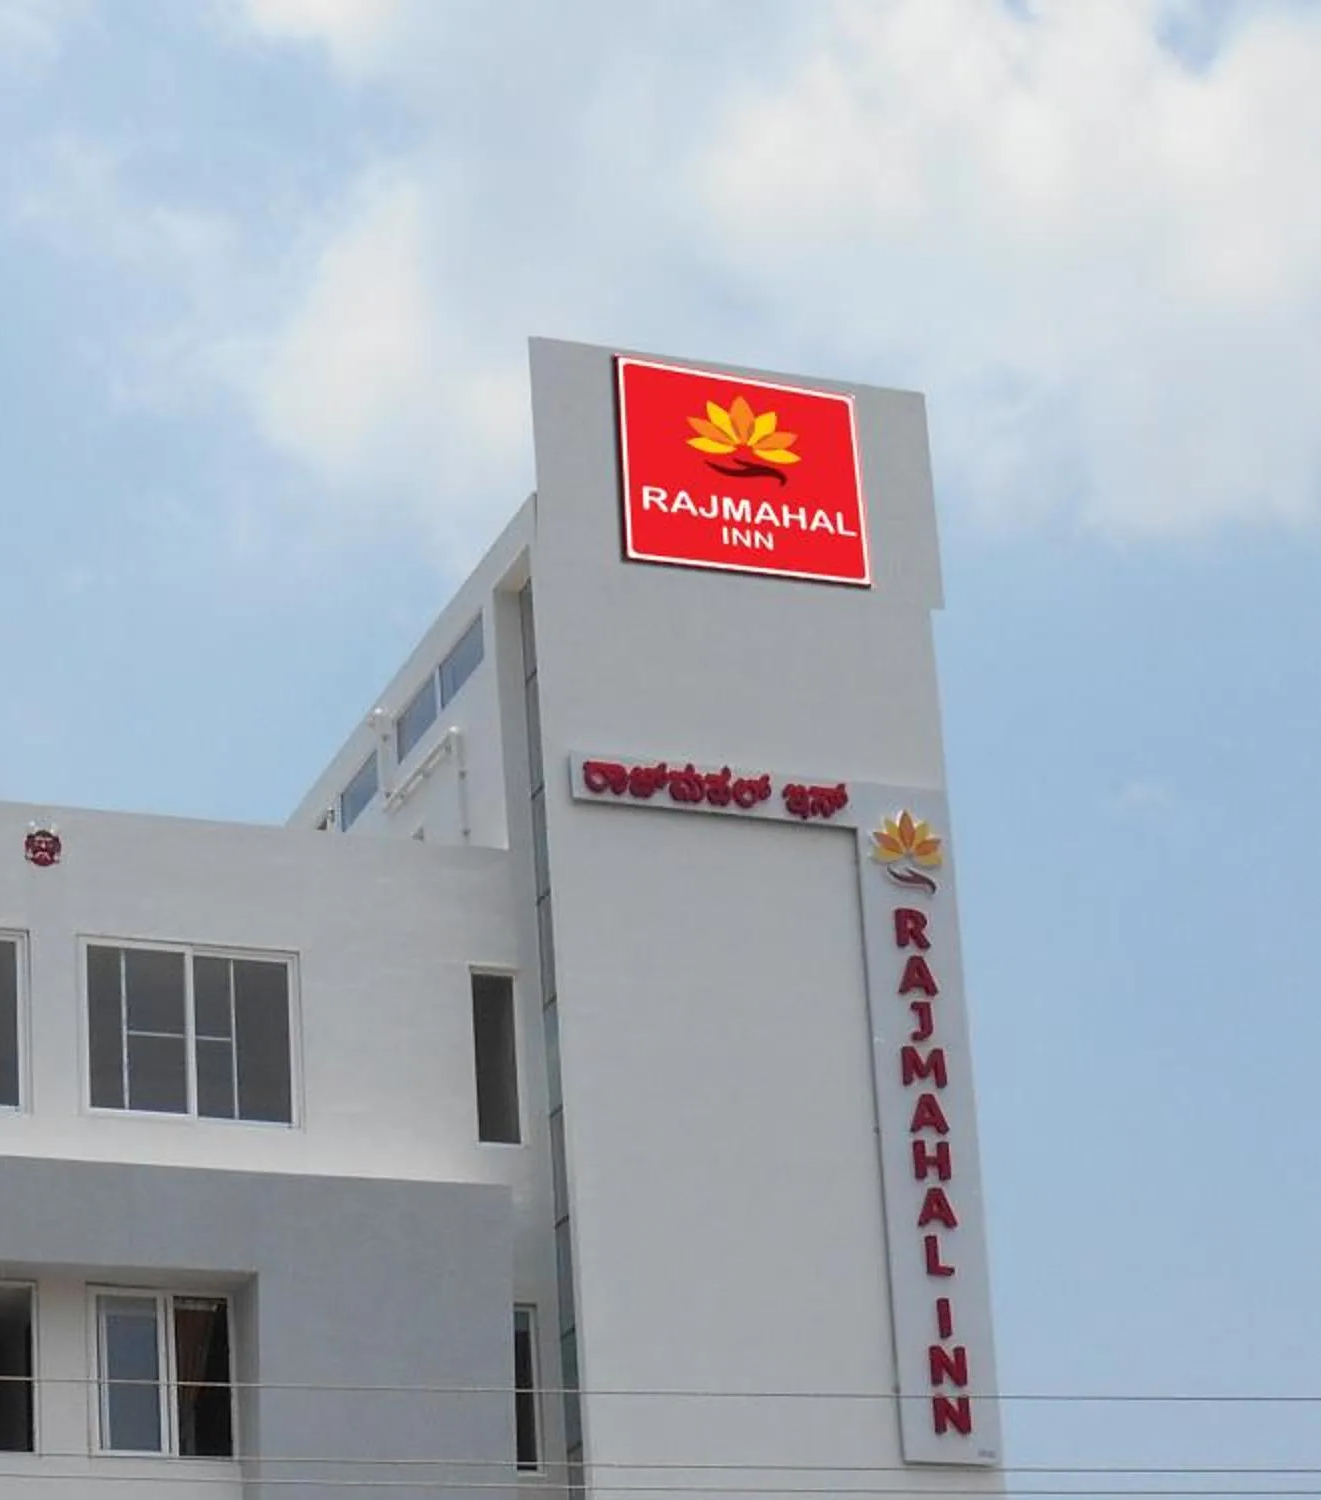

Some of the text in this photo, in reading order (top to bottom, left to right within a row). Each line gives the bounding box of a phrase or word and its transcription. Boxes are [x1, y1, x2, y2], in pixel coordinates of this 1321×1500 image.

[642, 485, 857, 537] RAJMAHAL
[722, 526, 774, 551] INN
[894, 907, 973, 1437] RAJMAHAL INN
